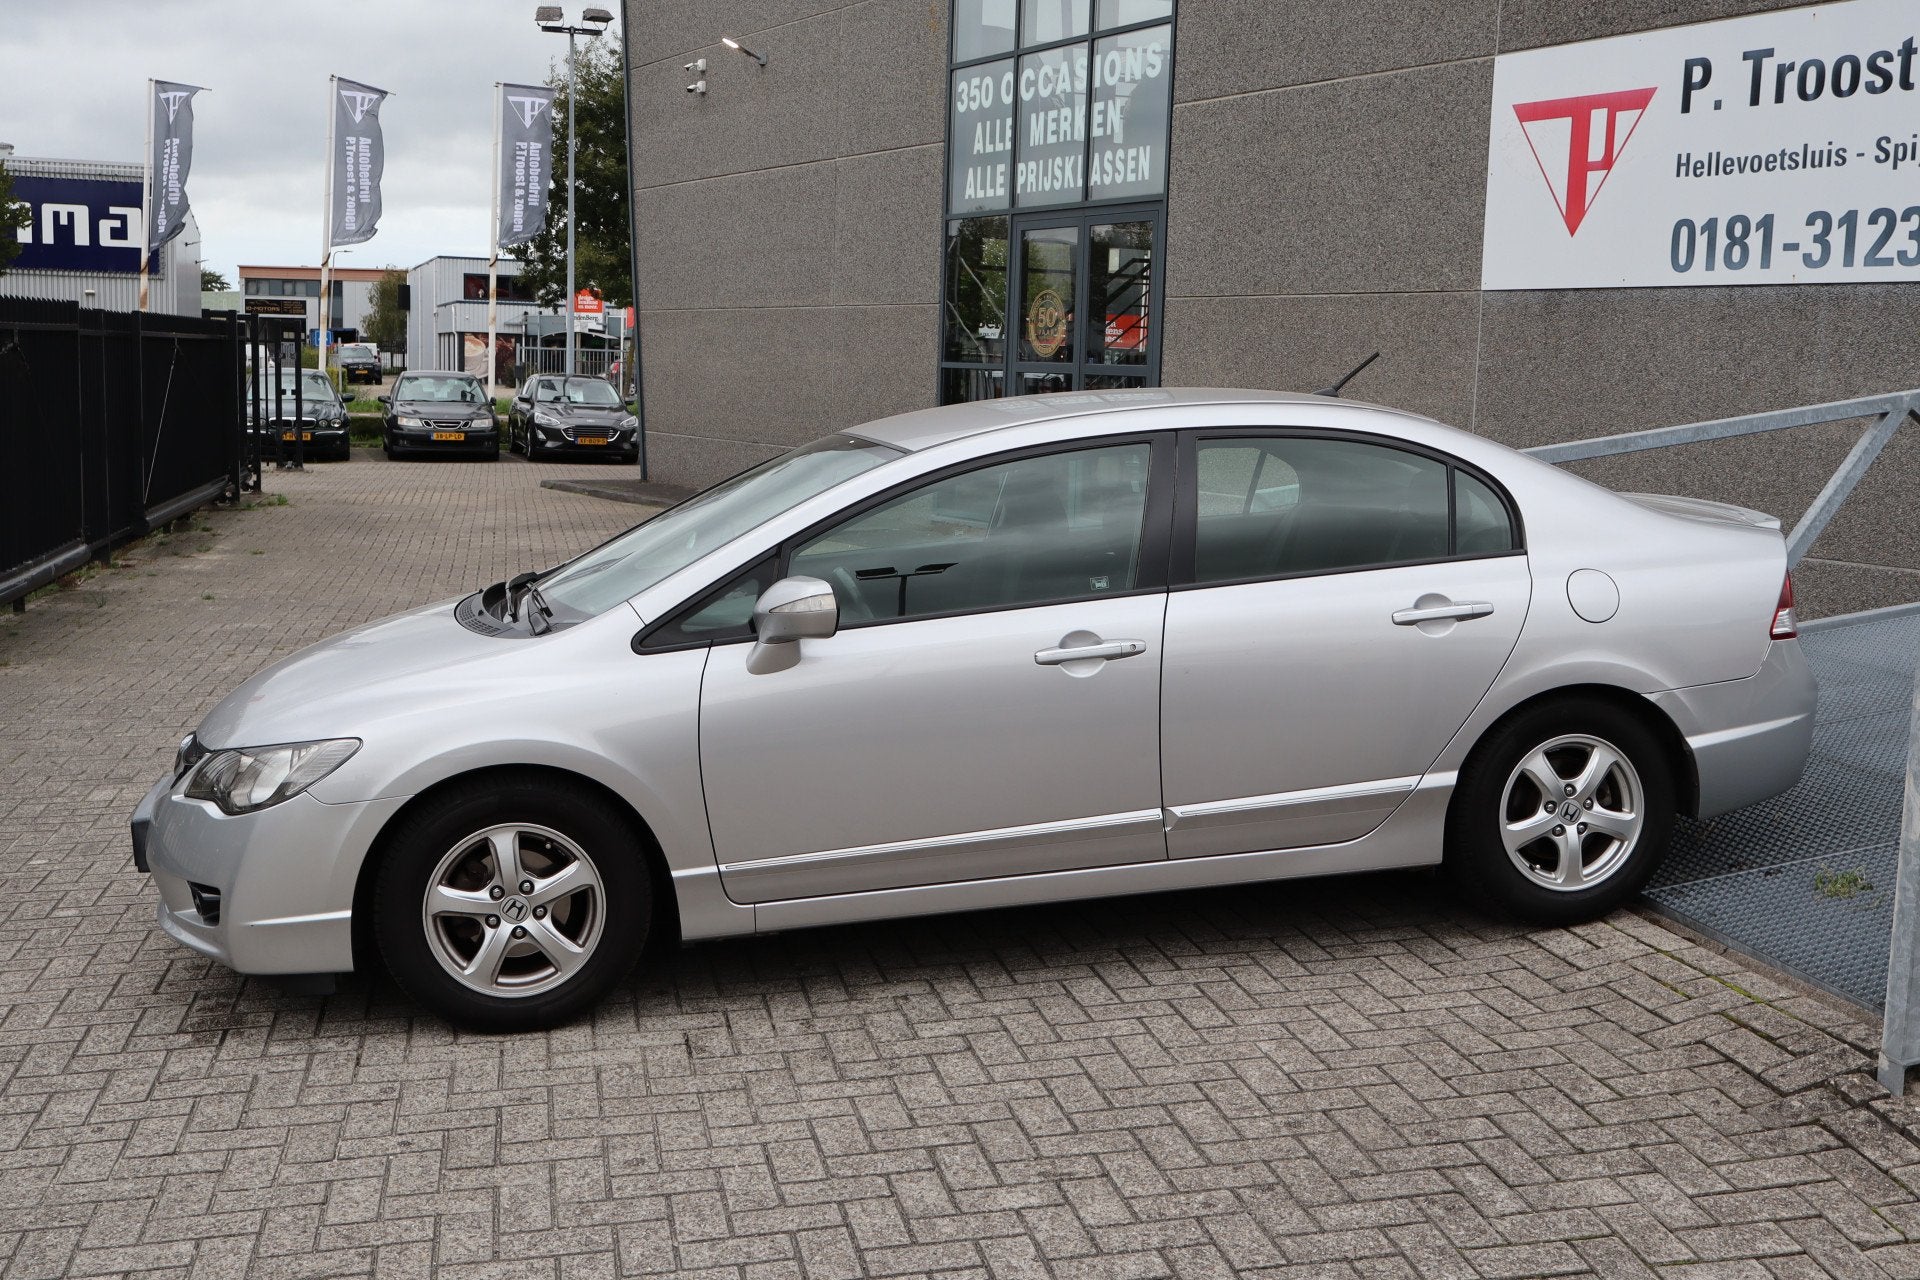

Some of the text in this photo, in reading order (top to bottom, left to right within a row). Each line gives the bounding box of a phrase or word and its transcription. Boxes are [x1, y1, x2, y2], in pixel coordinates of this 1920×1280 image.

[957, 42, 1162, 113] 350 OCCASIONS
[1680, 36, 1919, 114] P. Troost
[973, 99, 1121, 155] ALLE MERKEN
[358, 136, 372, 203] Autobedrijf
[528, 141, 542, 207] Autobedrijf
[964, 144, 1151, 200] ALLE PRIJSKLASSEN
[1675, 141, 1848, 178] Hellevoetsluis
[1874, 133, 1920, 171] Spi
[345, 195, 357, 231] zonen
[513, 198, 525, 232] zonen
[1037, 307, 1057, 328] 50
